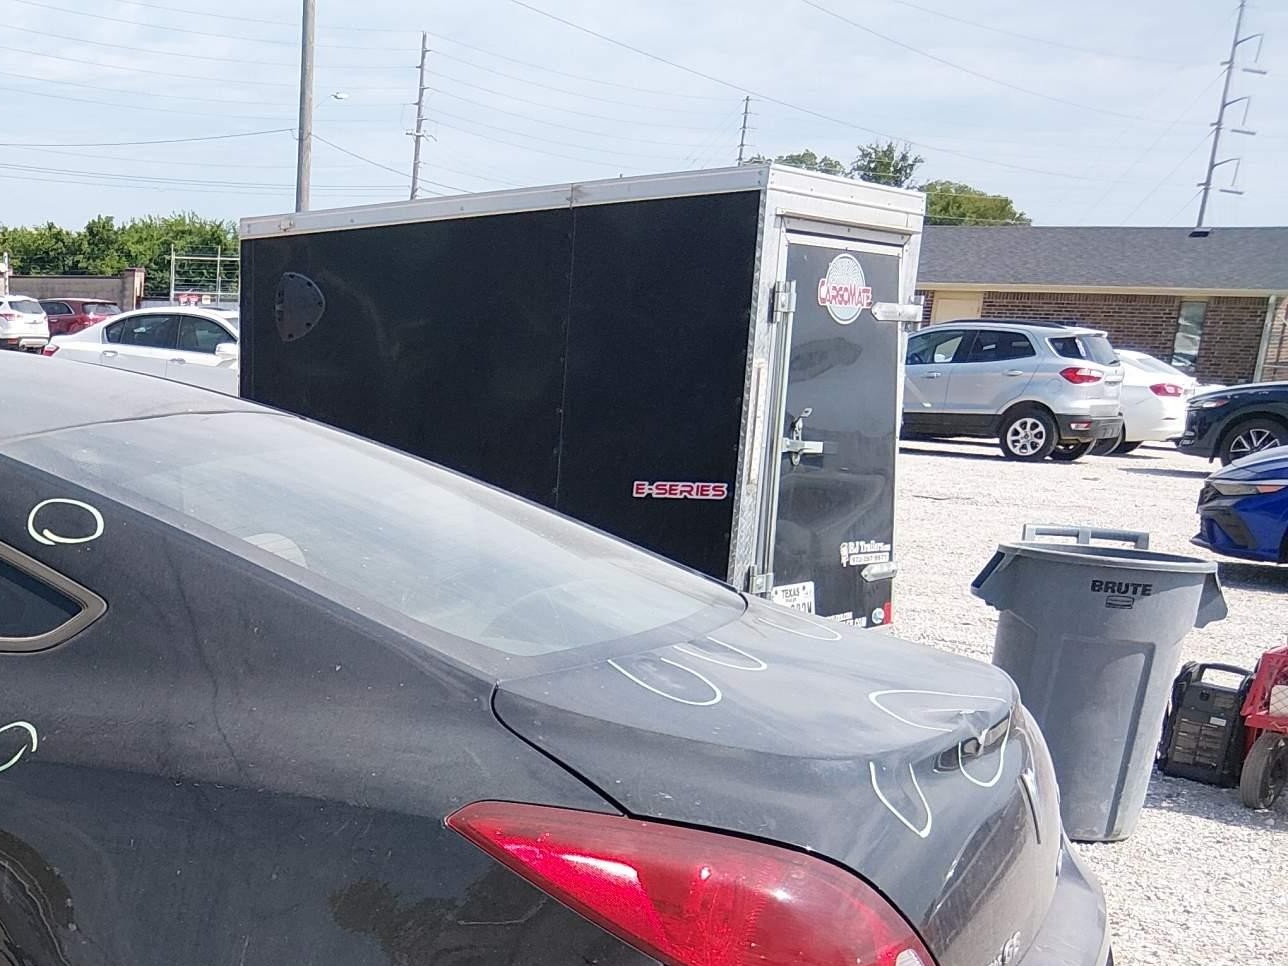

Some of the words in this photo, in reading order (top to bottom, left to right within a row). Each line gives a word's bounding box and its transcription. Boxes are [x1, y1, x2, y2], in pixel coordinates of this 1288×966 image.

[633, 481, 728, 499] E-SERIES
[782, 587, 800, 599] TEXAS
[1091, 580, 1152, 596] BRUTE
